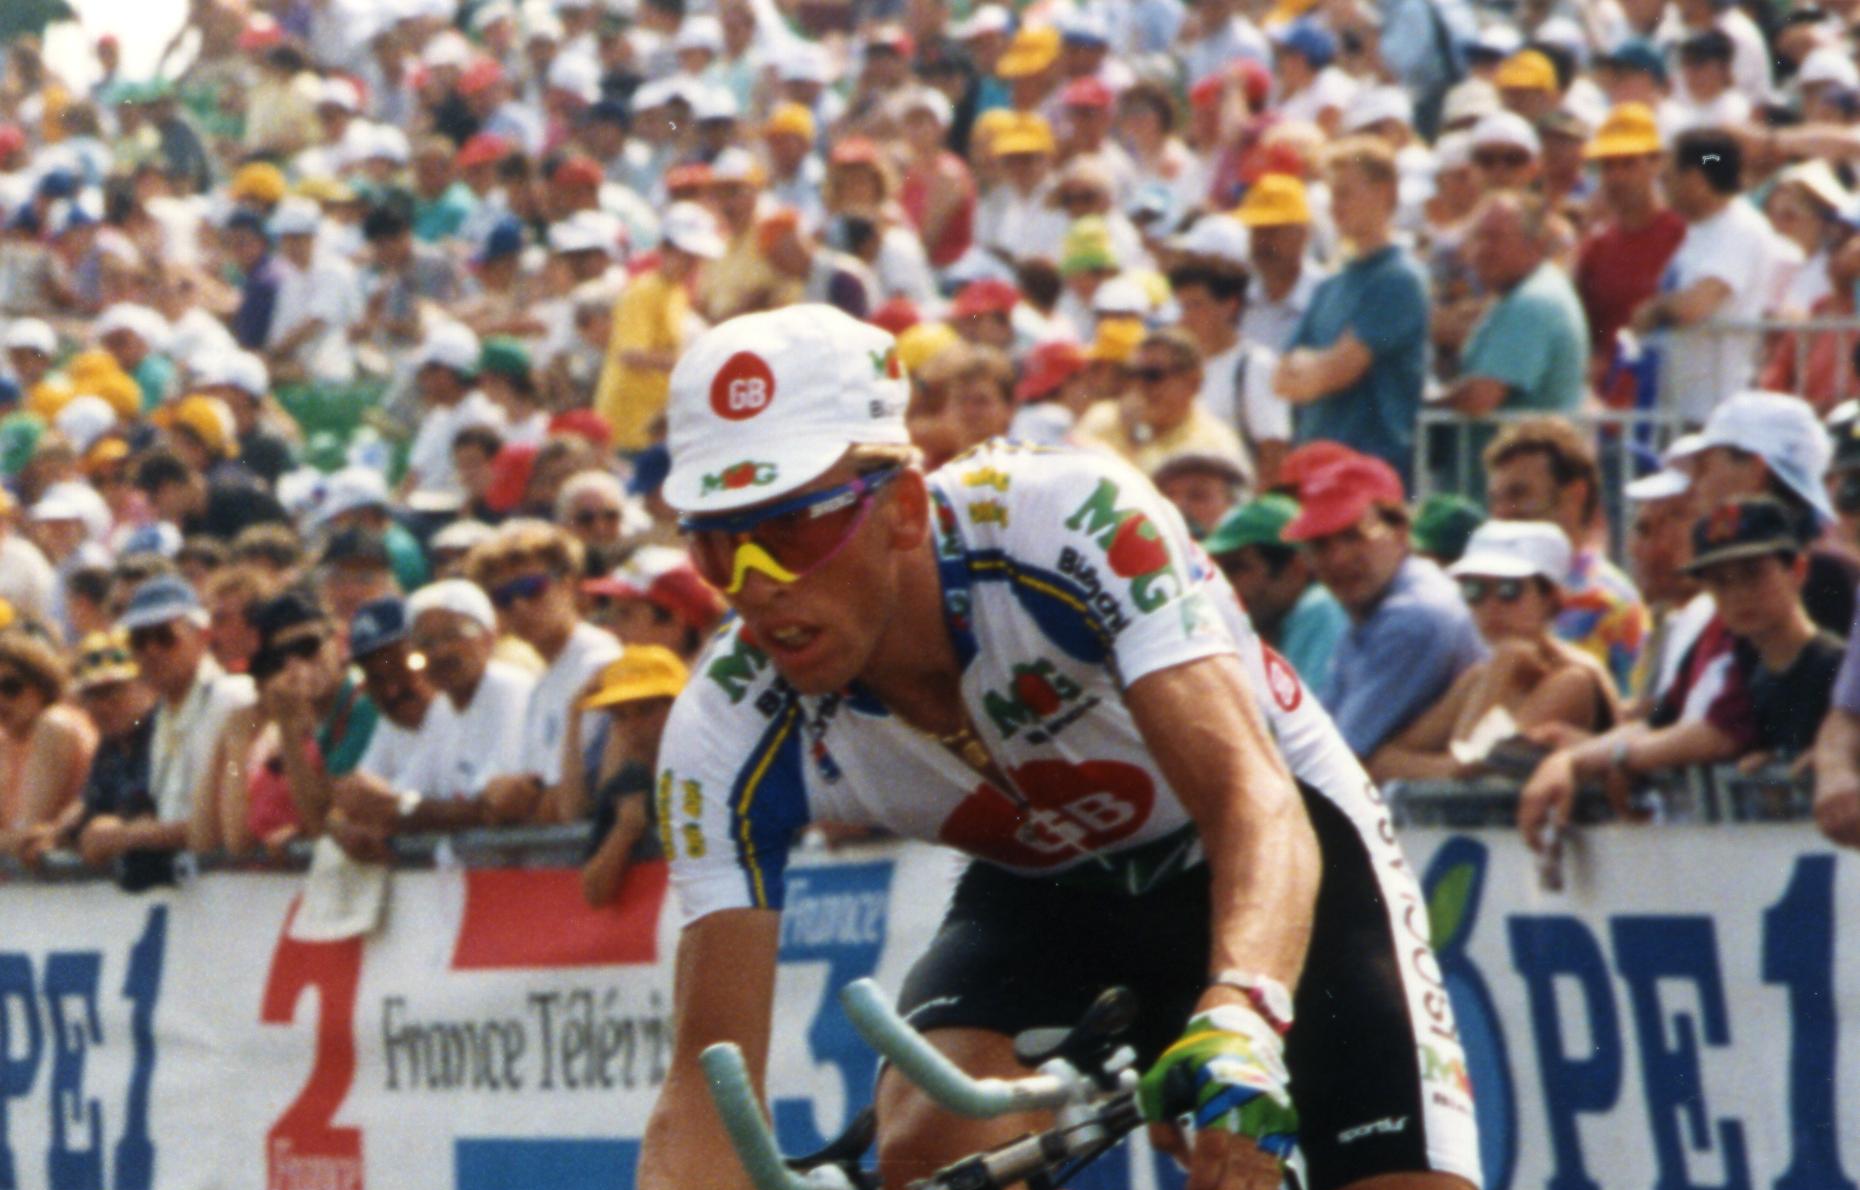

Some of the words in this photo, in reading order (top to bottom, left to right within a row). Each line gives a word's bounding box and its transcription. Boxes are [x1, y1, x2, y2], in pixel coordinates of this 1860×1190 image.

[729, 378, 767, 411] GB
[1014, 791, 1136, 854] GB
[381, 995, 526, 1090] France
[526, 986, 674, 1091] Télévi
